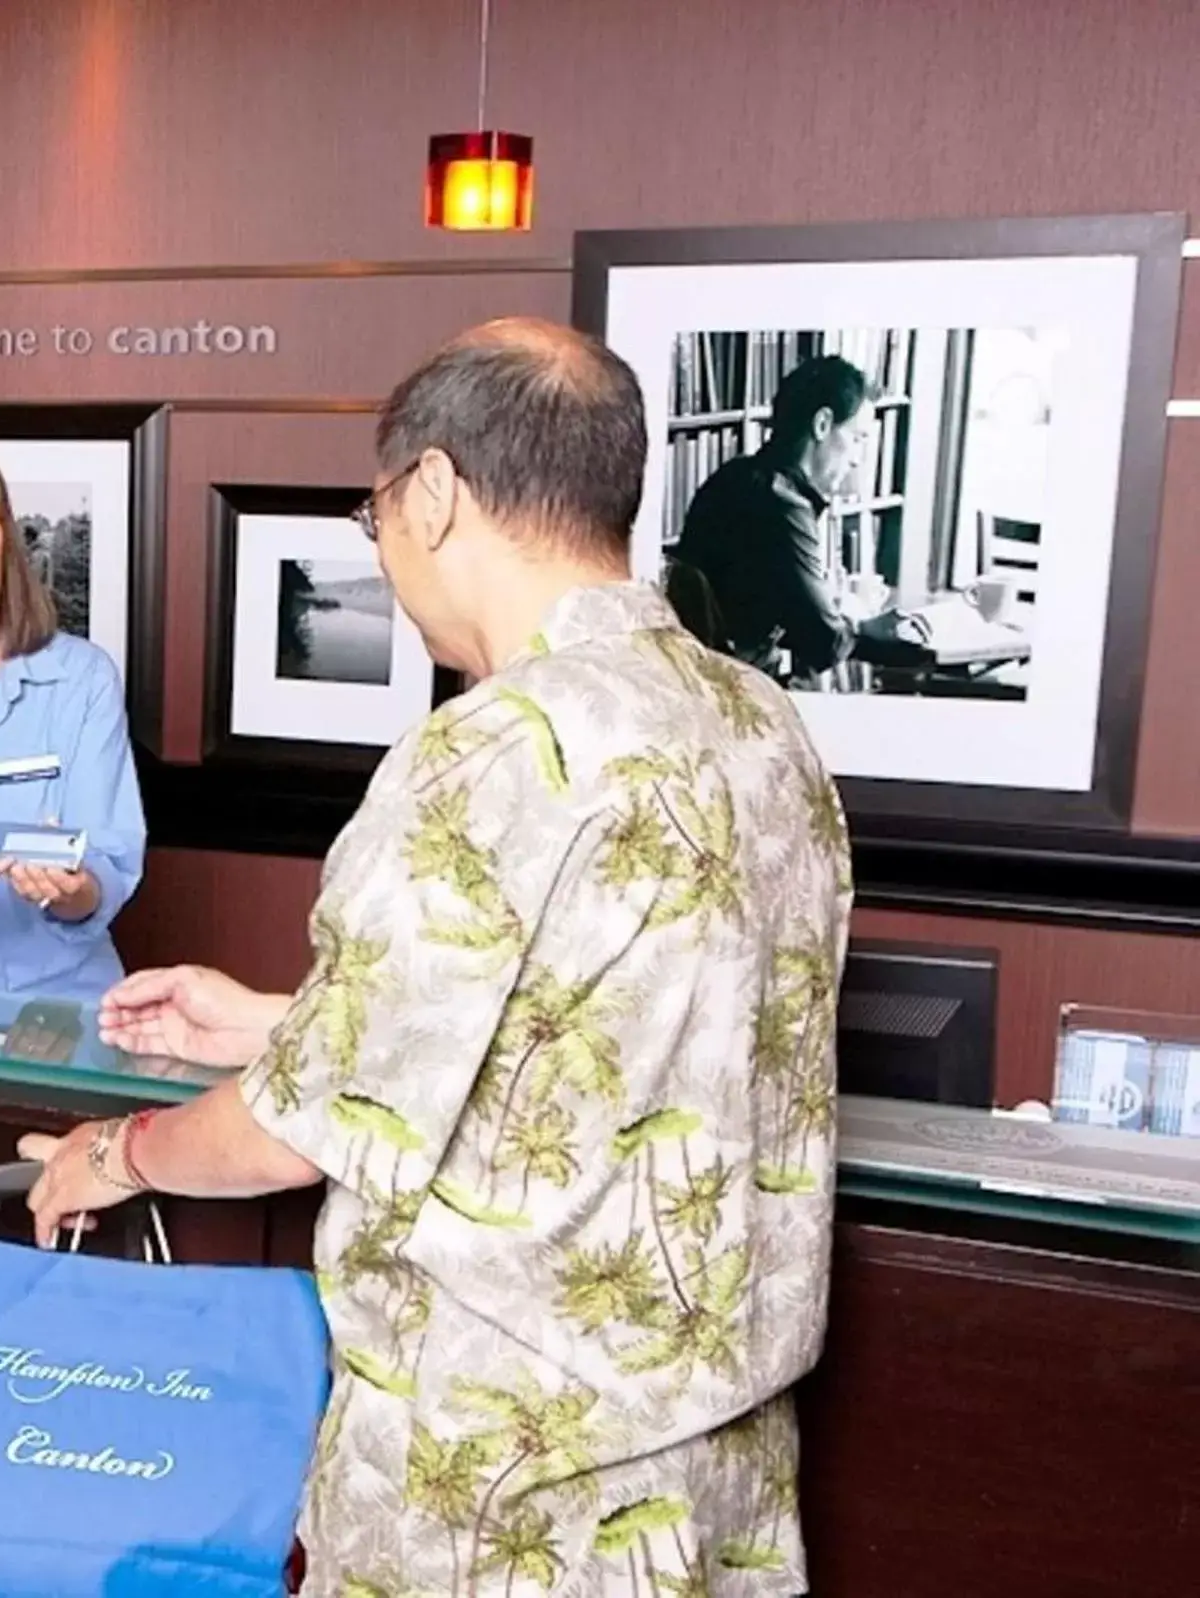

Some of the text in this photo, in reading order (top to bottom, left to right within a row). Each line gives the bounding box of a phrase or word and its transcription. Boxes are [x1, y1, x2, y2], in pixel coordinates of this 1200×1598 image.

[53, 324, 94, 354] to
[107, 319, 277, 354] canton
[146, 1368, 213, 1401] Inn
[6, 1425, 174, 1480] Canton
